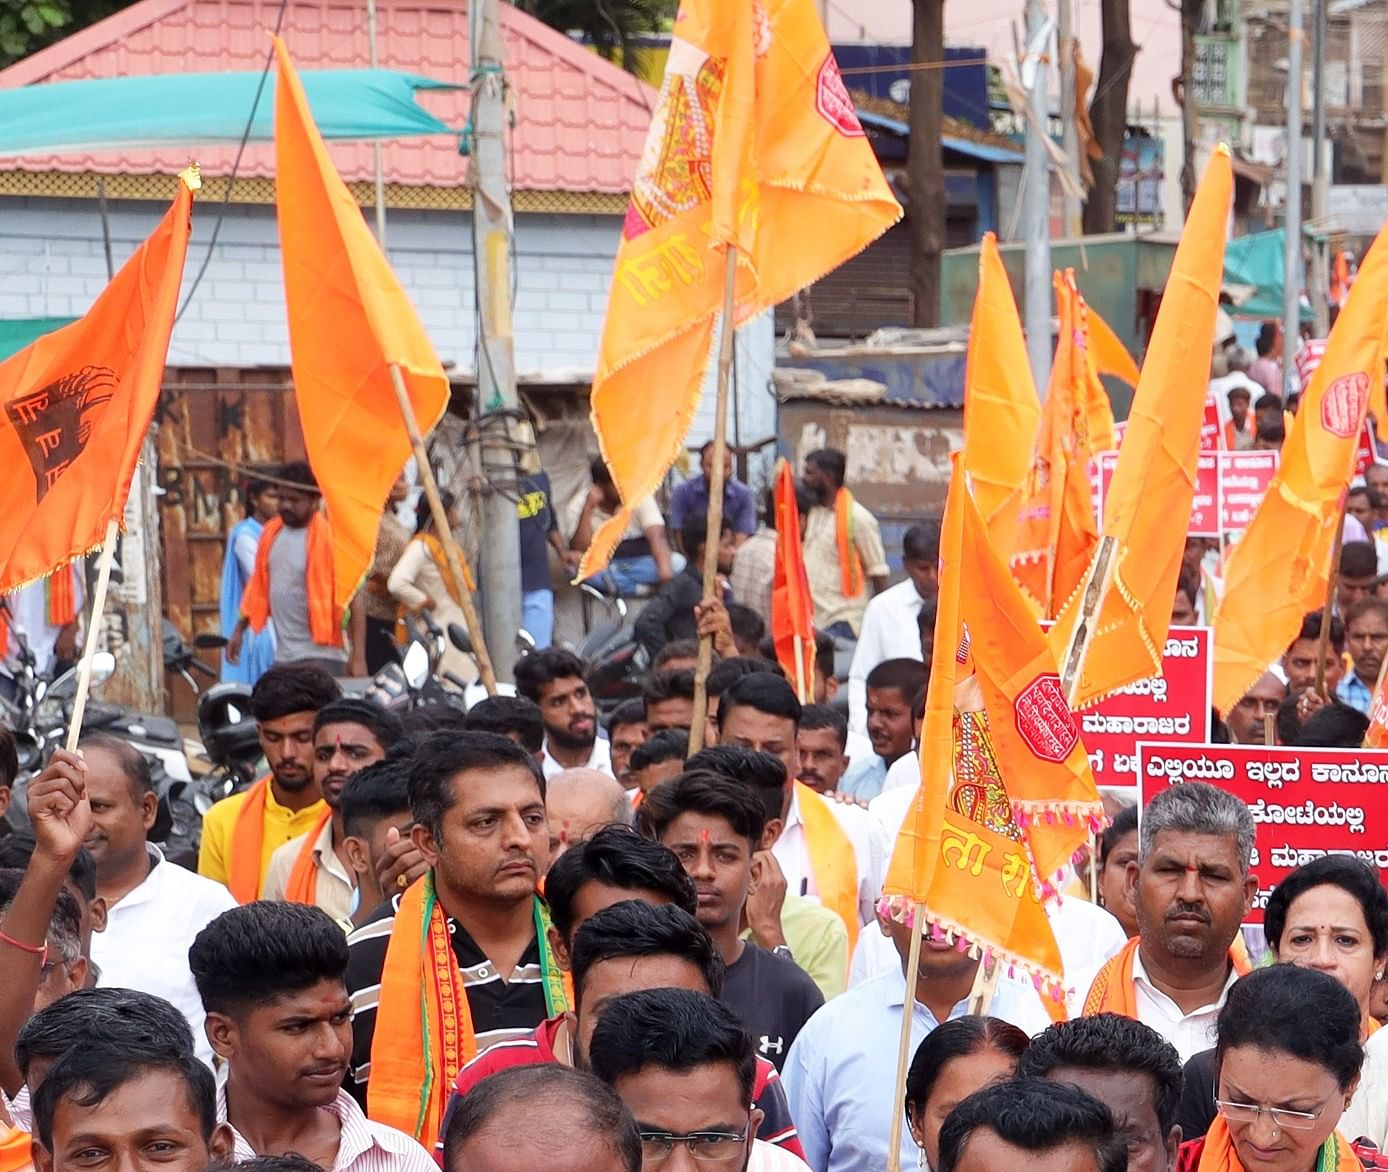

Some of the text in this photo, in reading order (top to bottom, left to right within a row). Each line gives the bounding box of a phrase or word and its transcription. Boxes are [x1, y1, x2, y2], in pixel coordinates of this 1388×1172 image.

[1082, 712, 1190, 735] ಮಹಾರಾಜರ
[1146, 754, 1235, 788] ಎಲ್ಲಿಯೂ
[1245, 757, 1301, 788] ಇಲ್ಲದ
